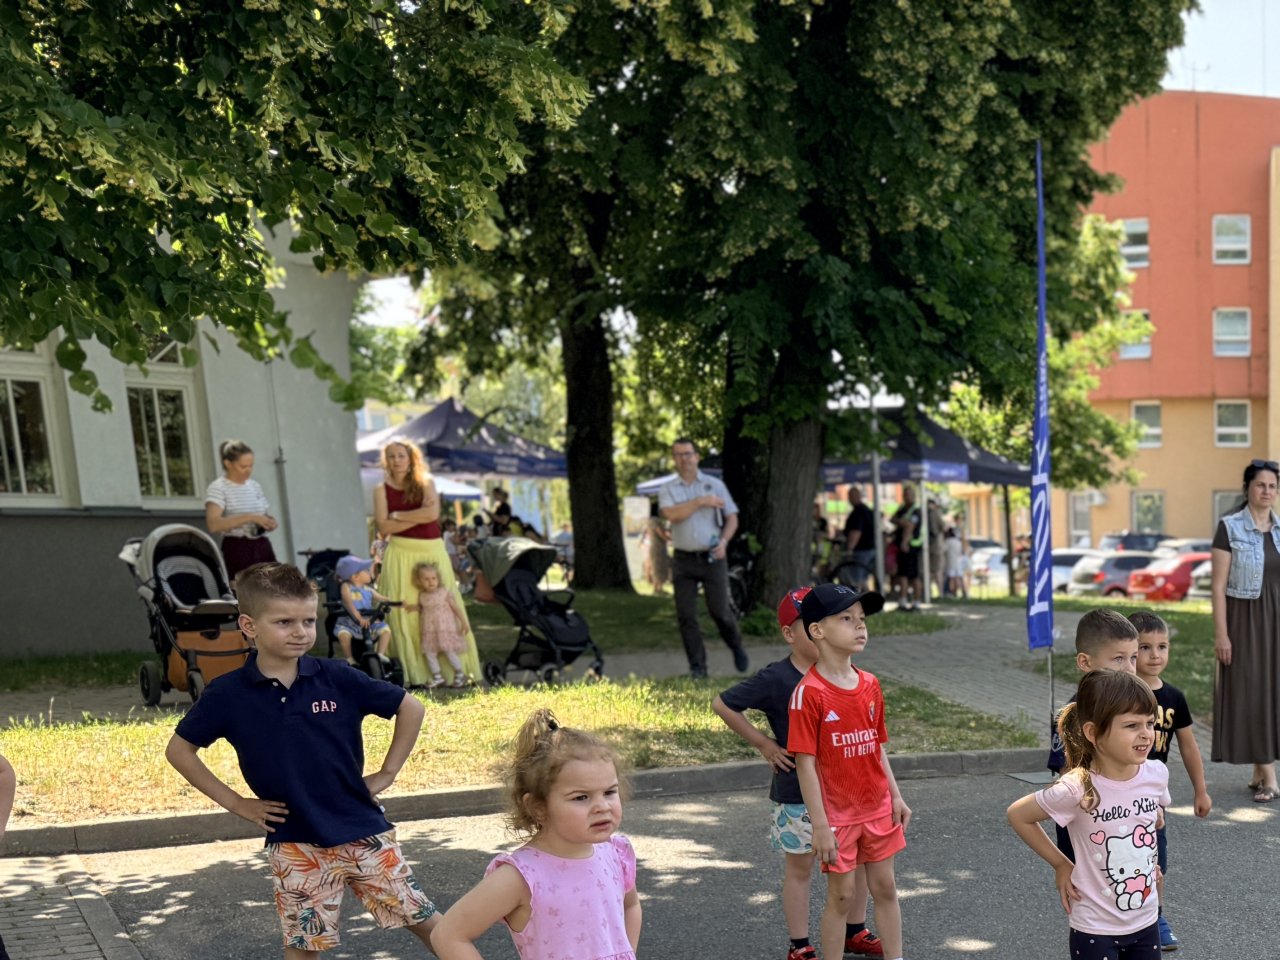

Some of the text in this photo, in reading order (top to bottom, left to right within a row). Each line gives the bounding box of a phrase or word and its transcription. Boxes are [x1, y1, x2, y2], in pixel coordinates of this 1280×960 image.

[312, 700, 337, 713] GAP
[844, 745, 856, 758] FLY
[1090, 805, 1131, 823] Hello
